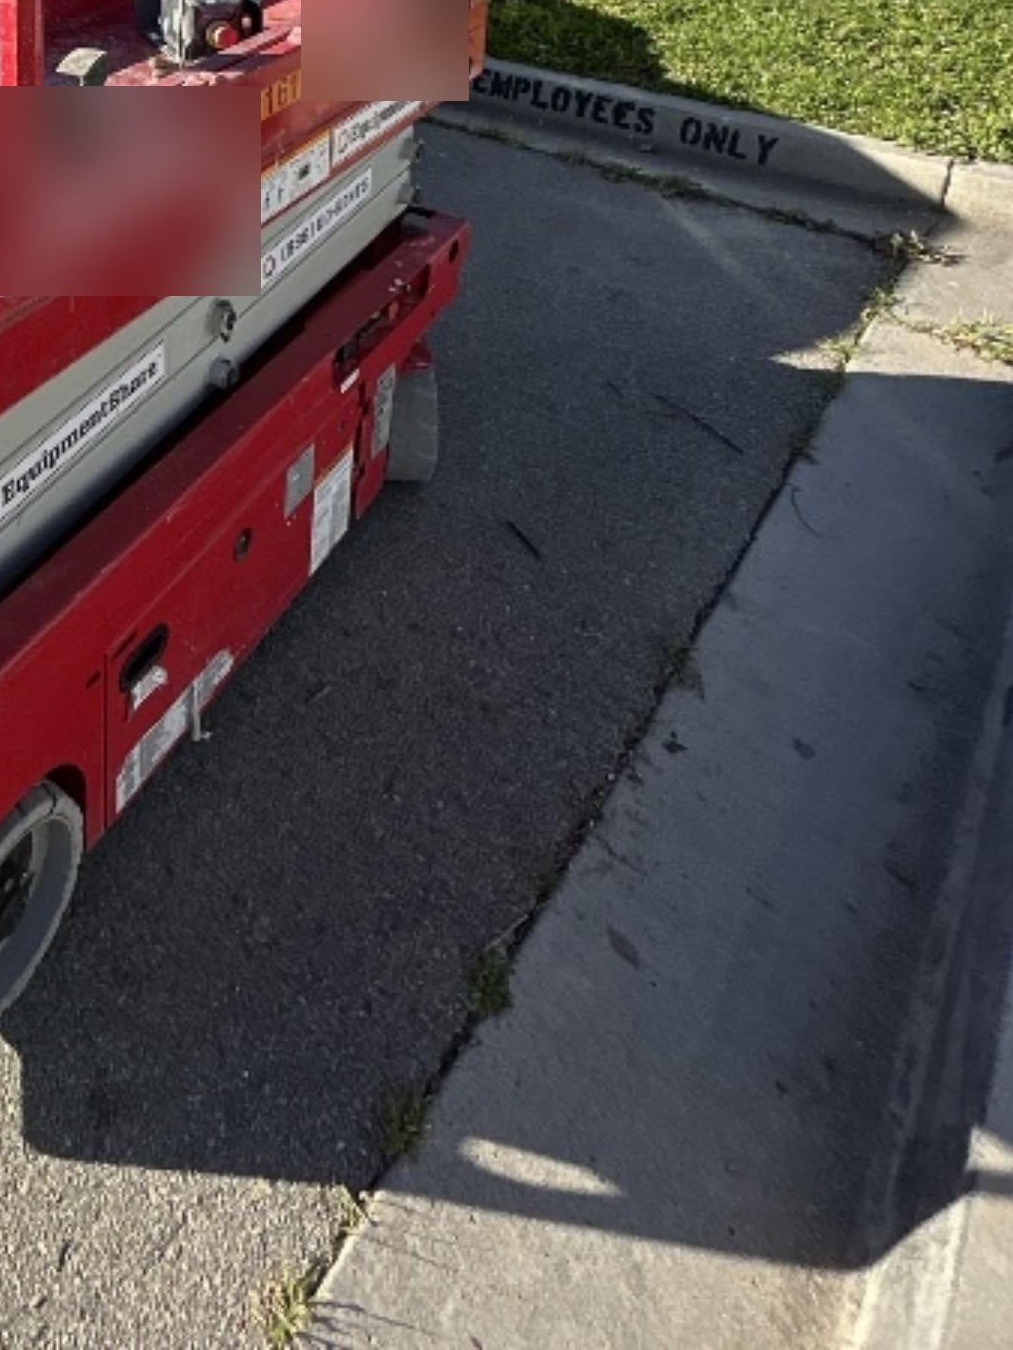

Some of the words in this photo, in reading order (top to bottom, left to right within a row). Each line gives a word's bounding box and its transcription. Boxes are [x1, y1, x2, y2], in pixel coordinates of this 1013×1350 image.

[473, 69, 655, 135] EMPLOYEES
[680, 116, 779, 166] ONLY
[2, 361, 157, 506] EquipmentShare
